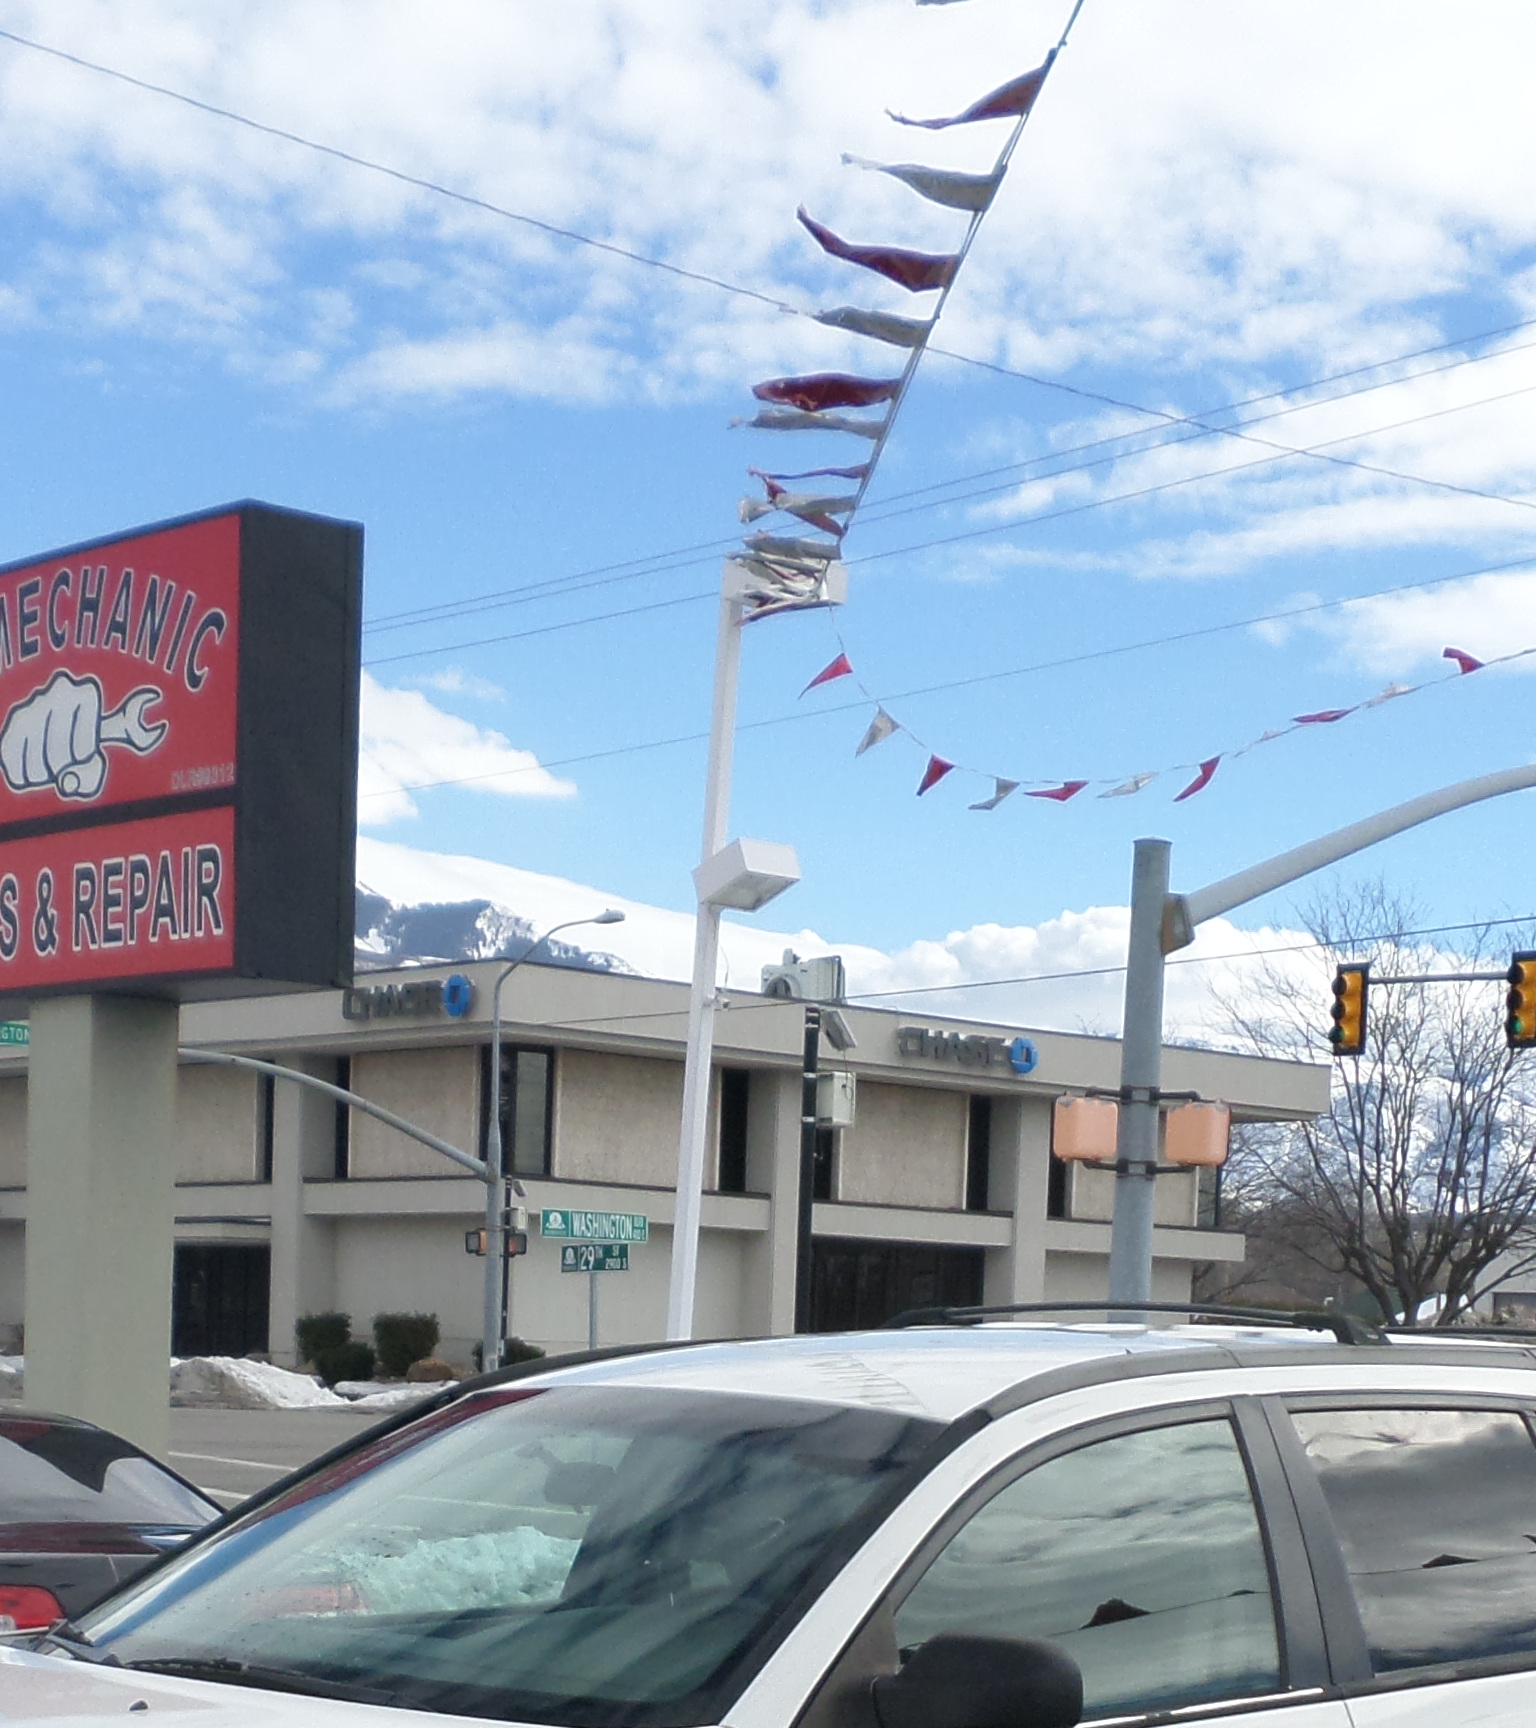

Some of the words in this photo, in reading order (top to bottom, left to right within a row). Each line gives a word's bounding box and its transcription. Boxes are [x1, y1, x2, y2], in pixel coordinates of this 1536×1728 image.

[32, 866, 60, 956] &
[71, 843, 225, 952] REPAIR
[898, 1026, 1009, 1068] CHASE
[572, 1211, 633, 1240] WASHINGTON
